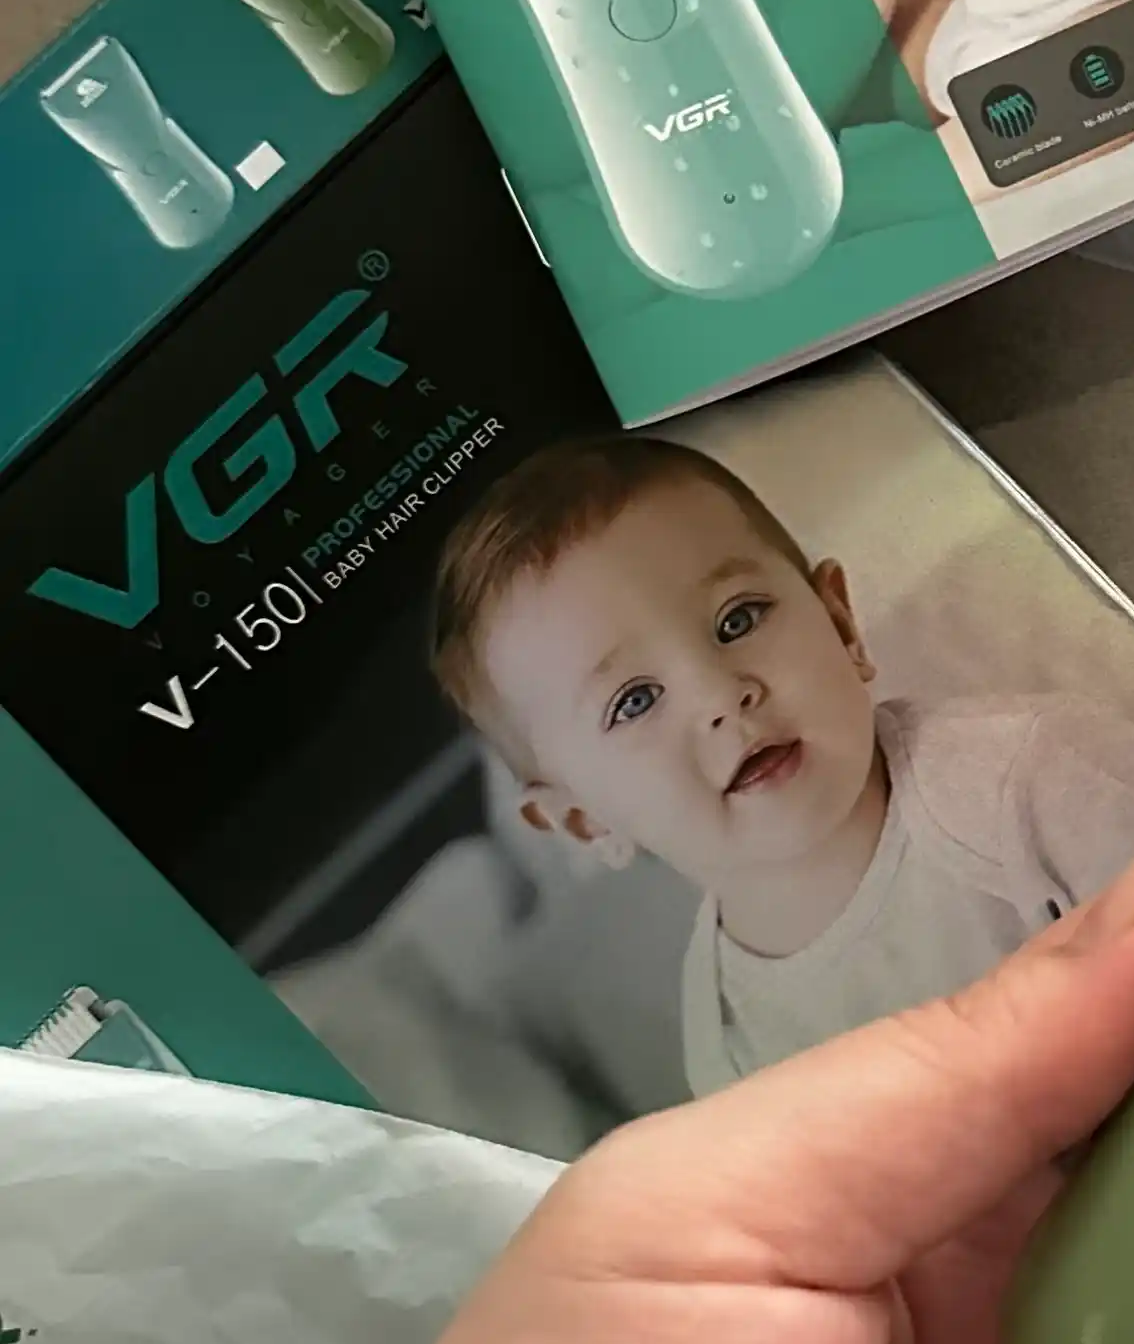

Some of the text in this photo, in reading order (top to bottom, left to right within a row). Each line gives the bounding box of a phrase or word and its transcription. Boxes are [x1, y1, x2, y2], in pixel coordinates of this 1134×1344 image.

[643, 93, 731, 142] VGR
[25, 288, 409, 629] VGR
[302, 403, 480, 568] PROFESSIONAL
[321, 416, 505, 590] BABY HAIR CLIPPER
